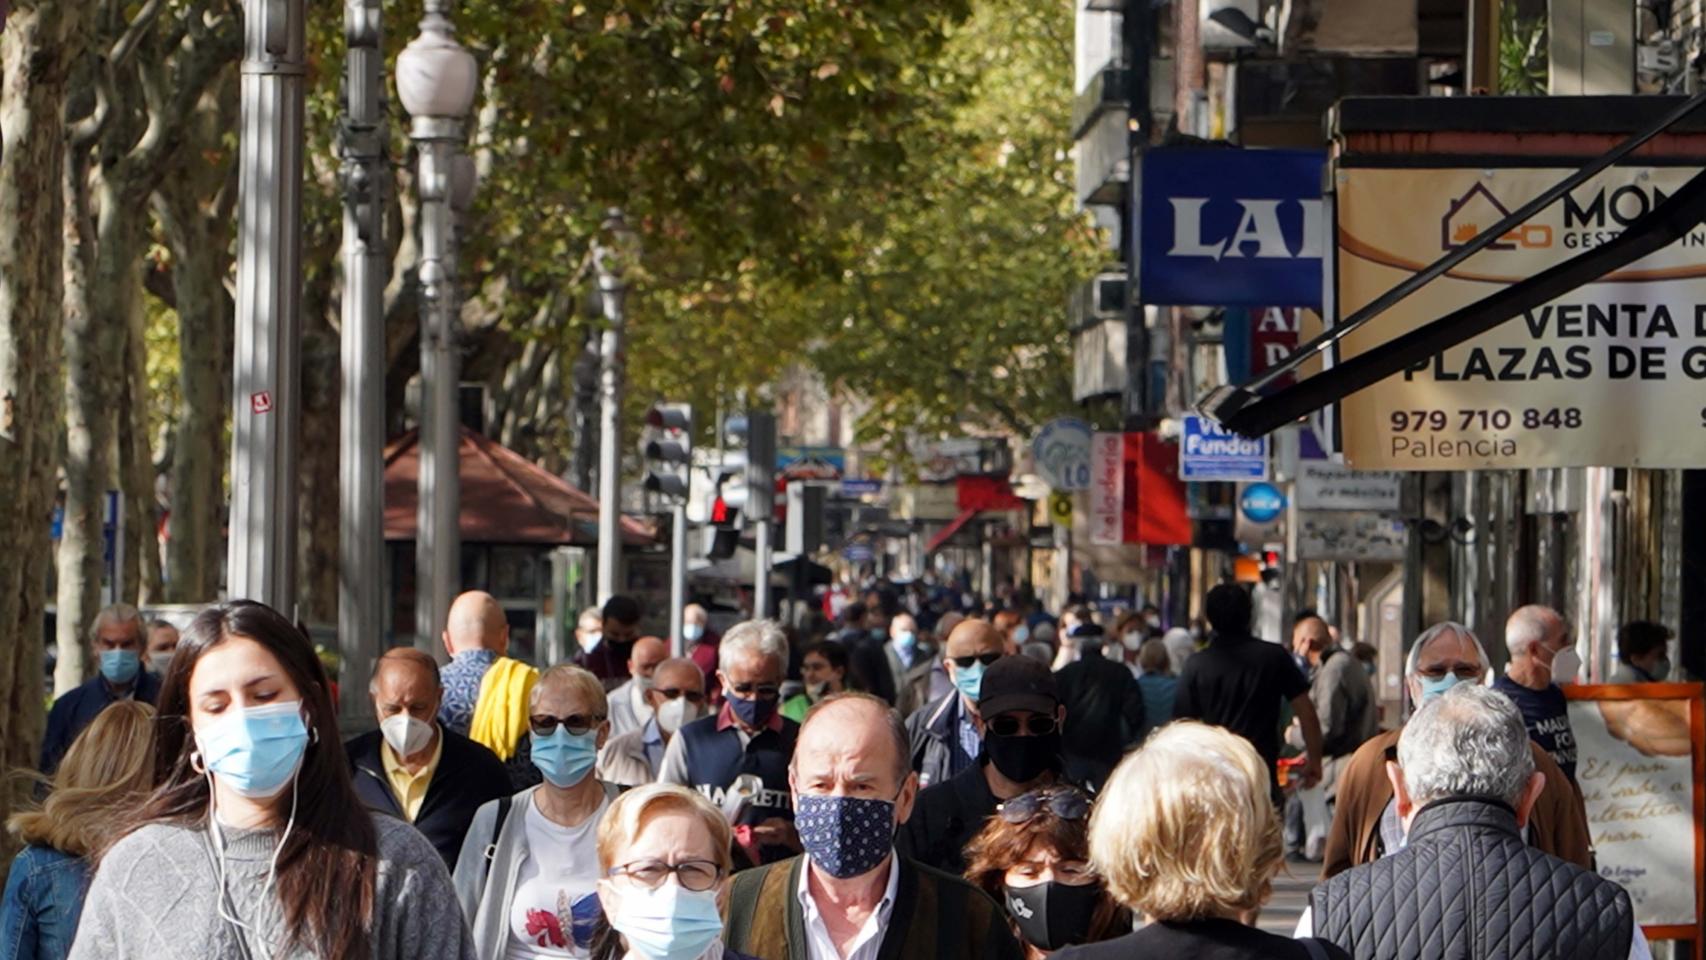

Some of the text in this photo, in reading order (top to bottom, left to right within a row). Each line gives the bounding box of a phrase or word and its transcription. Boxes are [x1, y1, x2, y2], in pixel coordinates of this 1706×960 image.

[1523, 304, 1679, 339] VENTA
[1608, 345, 1667, 380] DE
[1391, 407, 1582, 432] 979 710 848
[1391, 434, 1517, 458] Palencia
